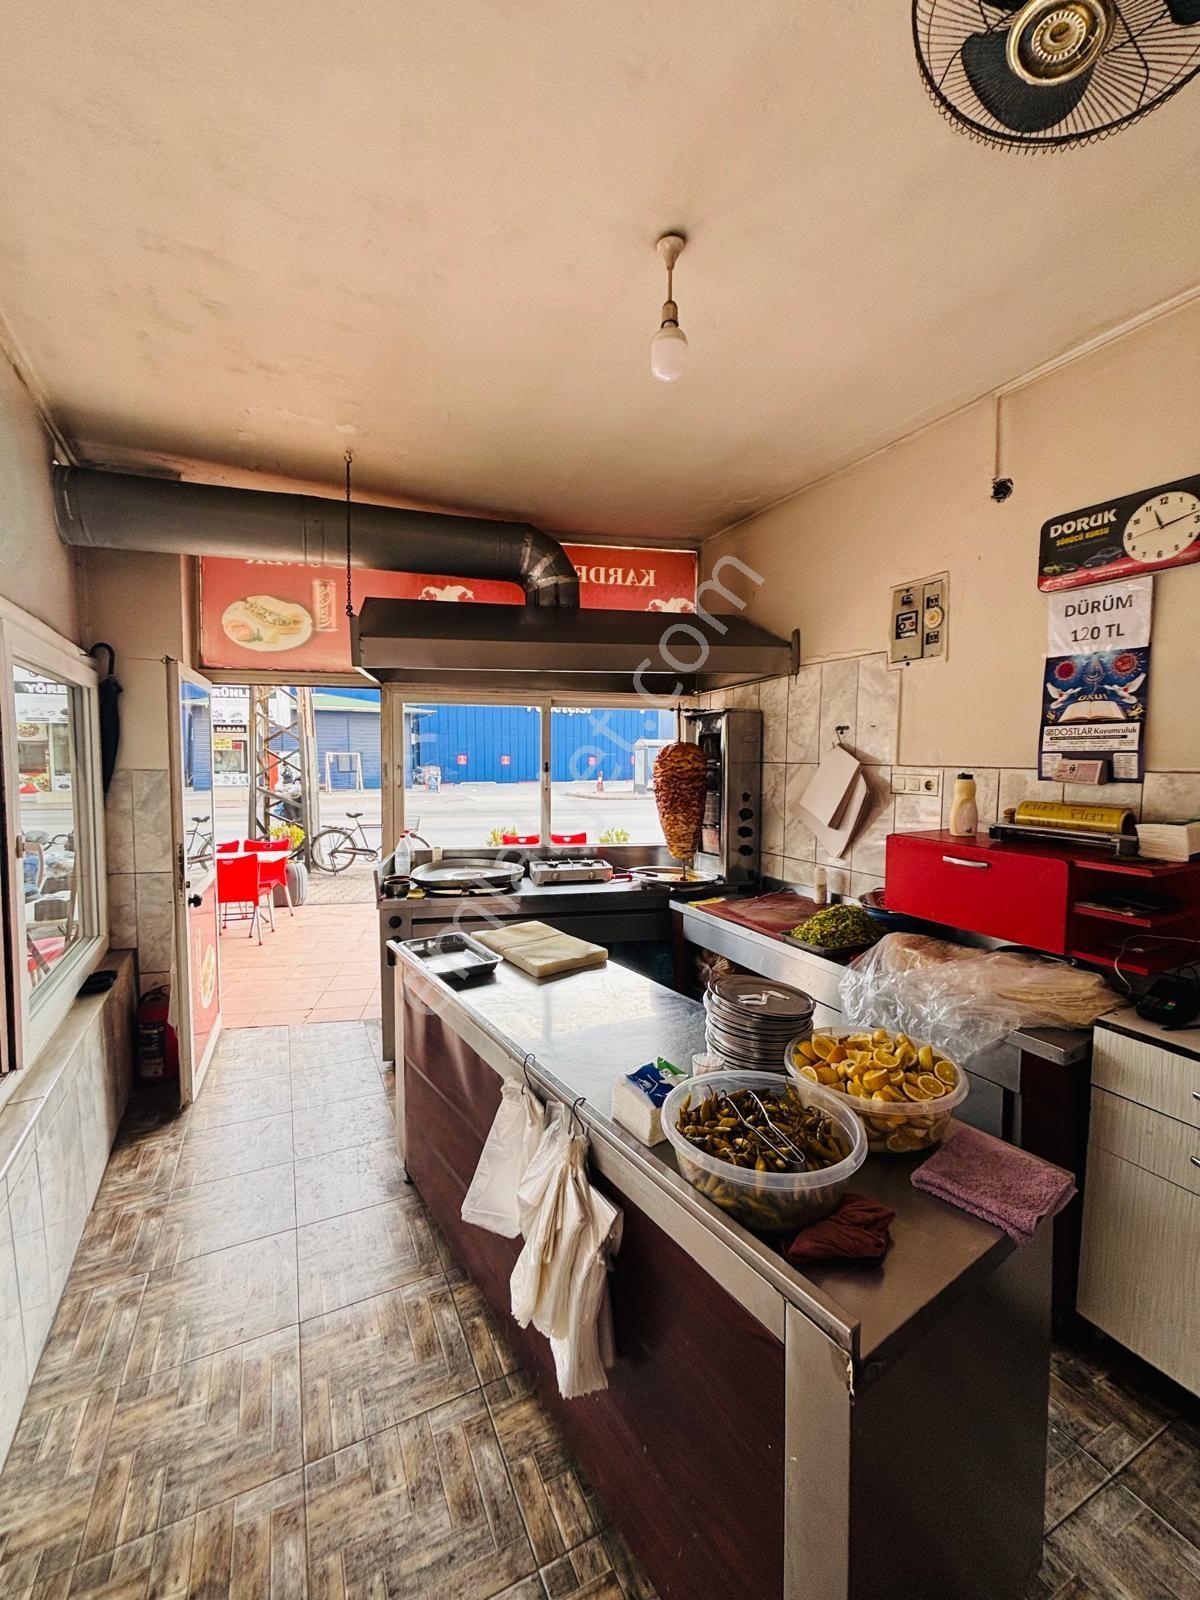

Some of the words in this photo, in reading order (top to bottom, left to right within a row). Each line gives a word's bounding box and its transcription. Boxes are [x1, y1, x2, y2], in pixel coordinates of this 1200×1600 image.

[1160, 496, 1169, 505] 12
[1050, 508, 1117, 538] DORUK
[1126, 532, 1132, 541] 9
[1156, 550, 1163, 559] 6
[1065, 594, 1133, 617] DÜRÜM
[1071, 626, 1100, 642] 120
[1104, 623, 1125, 638] TL
[1055, 727, 1093, 736] DOSTLAR
[1094, 726, 1137, 734] Kuyumculuk
